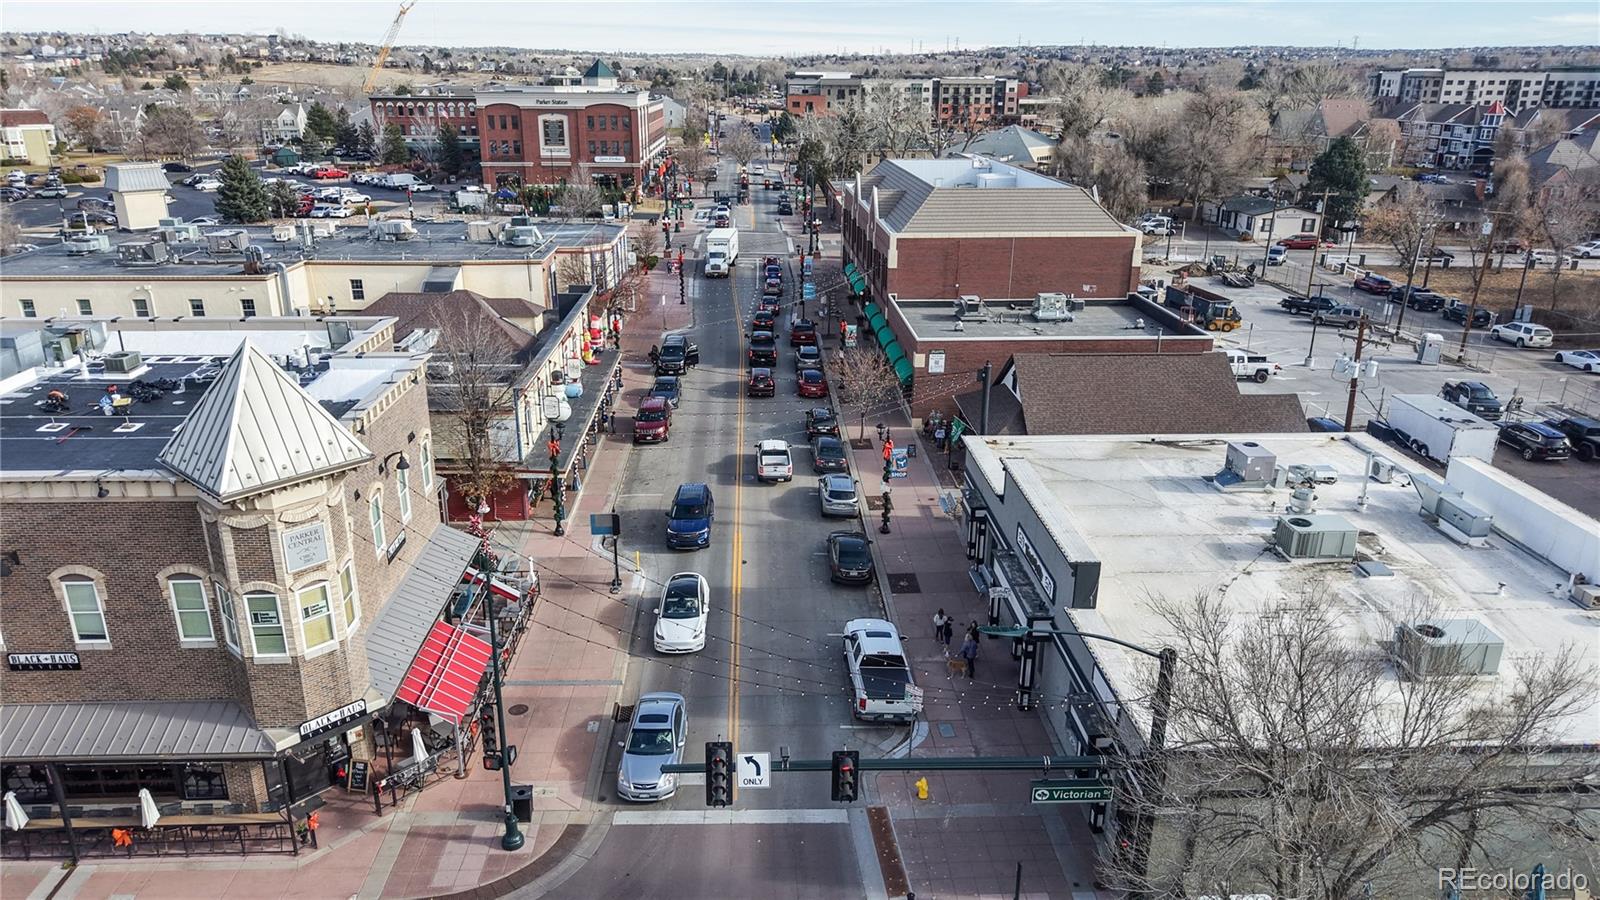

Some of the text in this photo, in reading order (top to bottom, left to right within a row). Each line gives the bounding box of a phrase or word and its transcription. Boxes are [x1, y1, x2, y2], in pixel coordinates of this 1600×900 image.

[290, 529, 319, 541] PARKER
[288, 535, 321, 549] CENTRAL
[10, 654, 77, 664] BLACK HAUS
[302, 701, 363, 734] BLACK HAUS
[1052, 789, 1101, 799] Victorian
